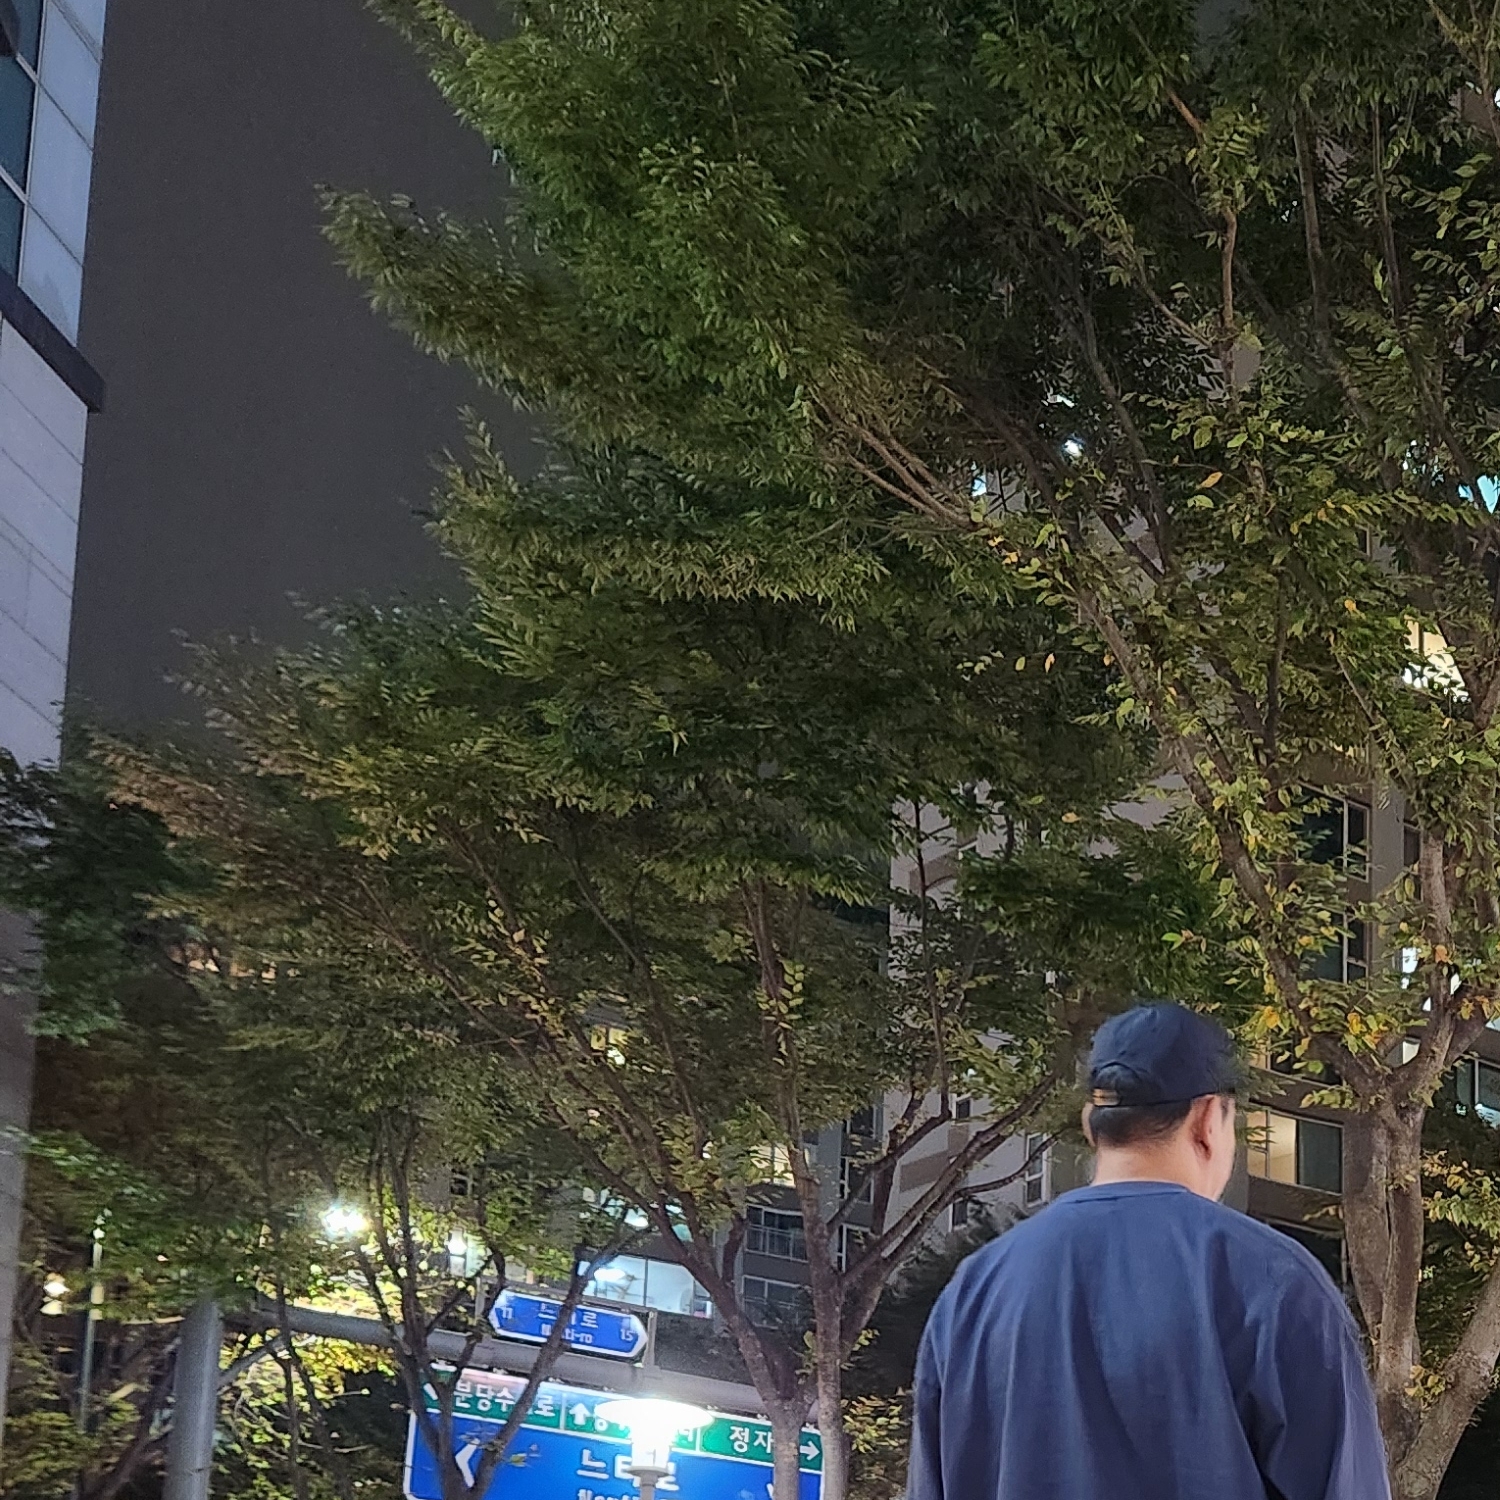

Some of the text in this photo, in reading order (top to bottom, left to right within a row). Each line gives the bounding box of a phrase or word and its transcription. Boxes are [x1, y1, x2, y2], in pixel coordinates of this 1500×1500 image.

[538, 1302, 598, 1328] 느로
[620, 1328, 634, 1341] 15
[453, 1380, 556, 1417] 분당수로
